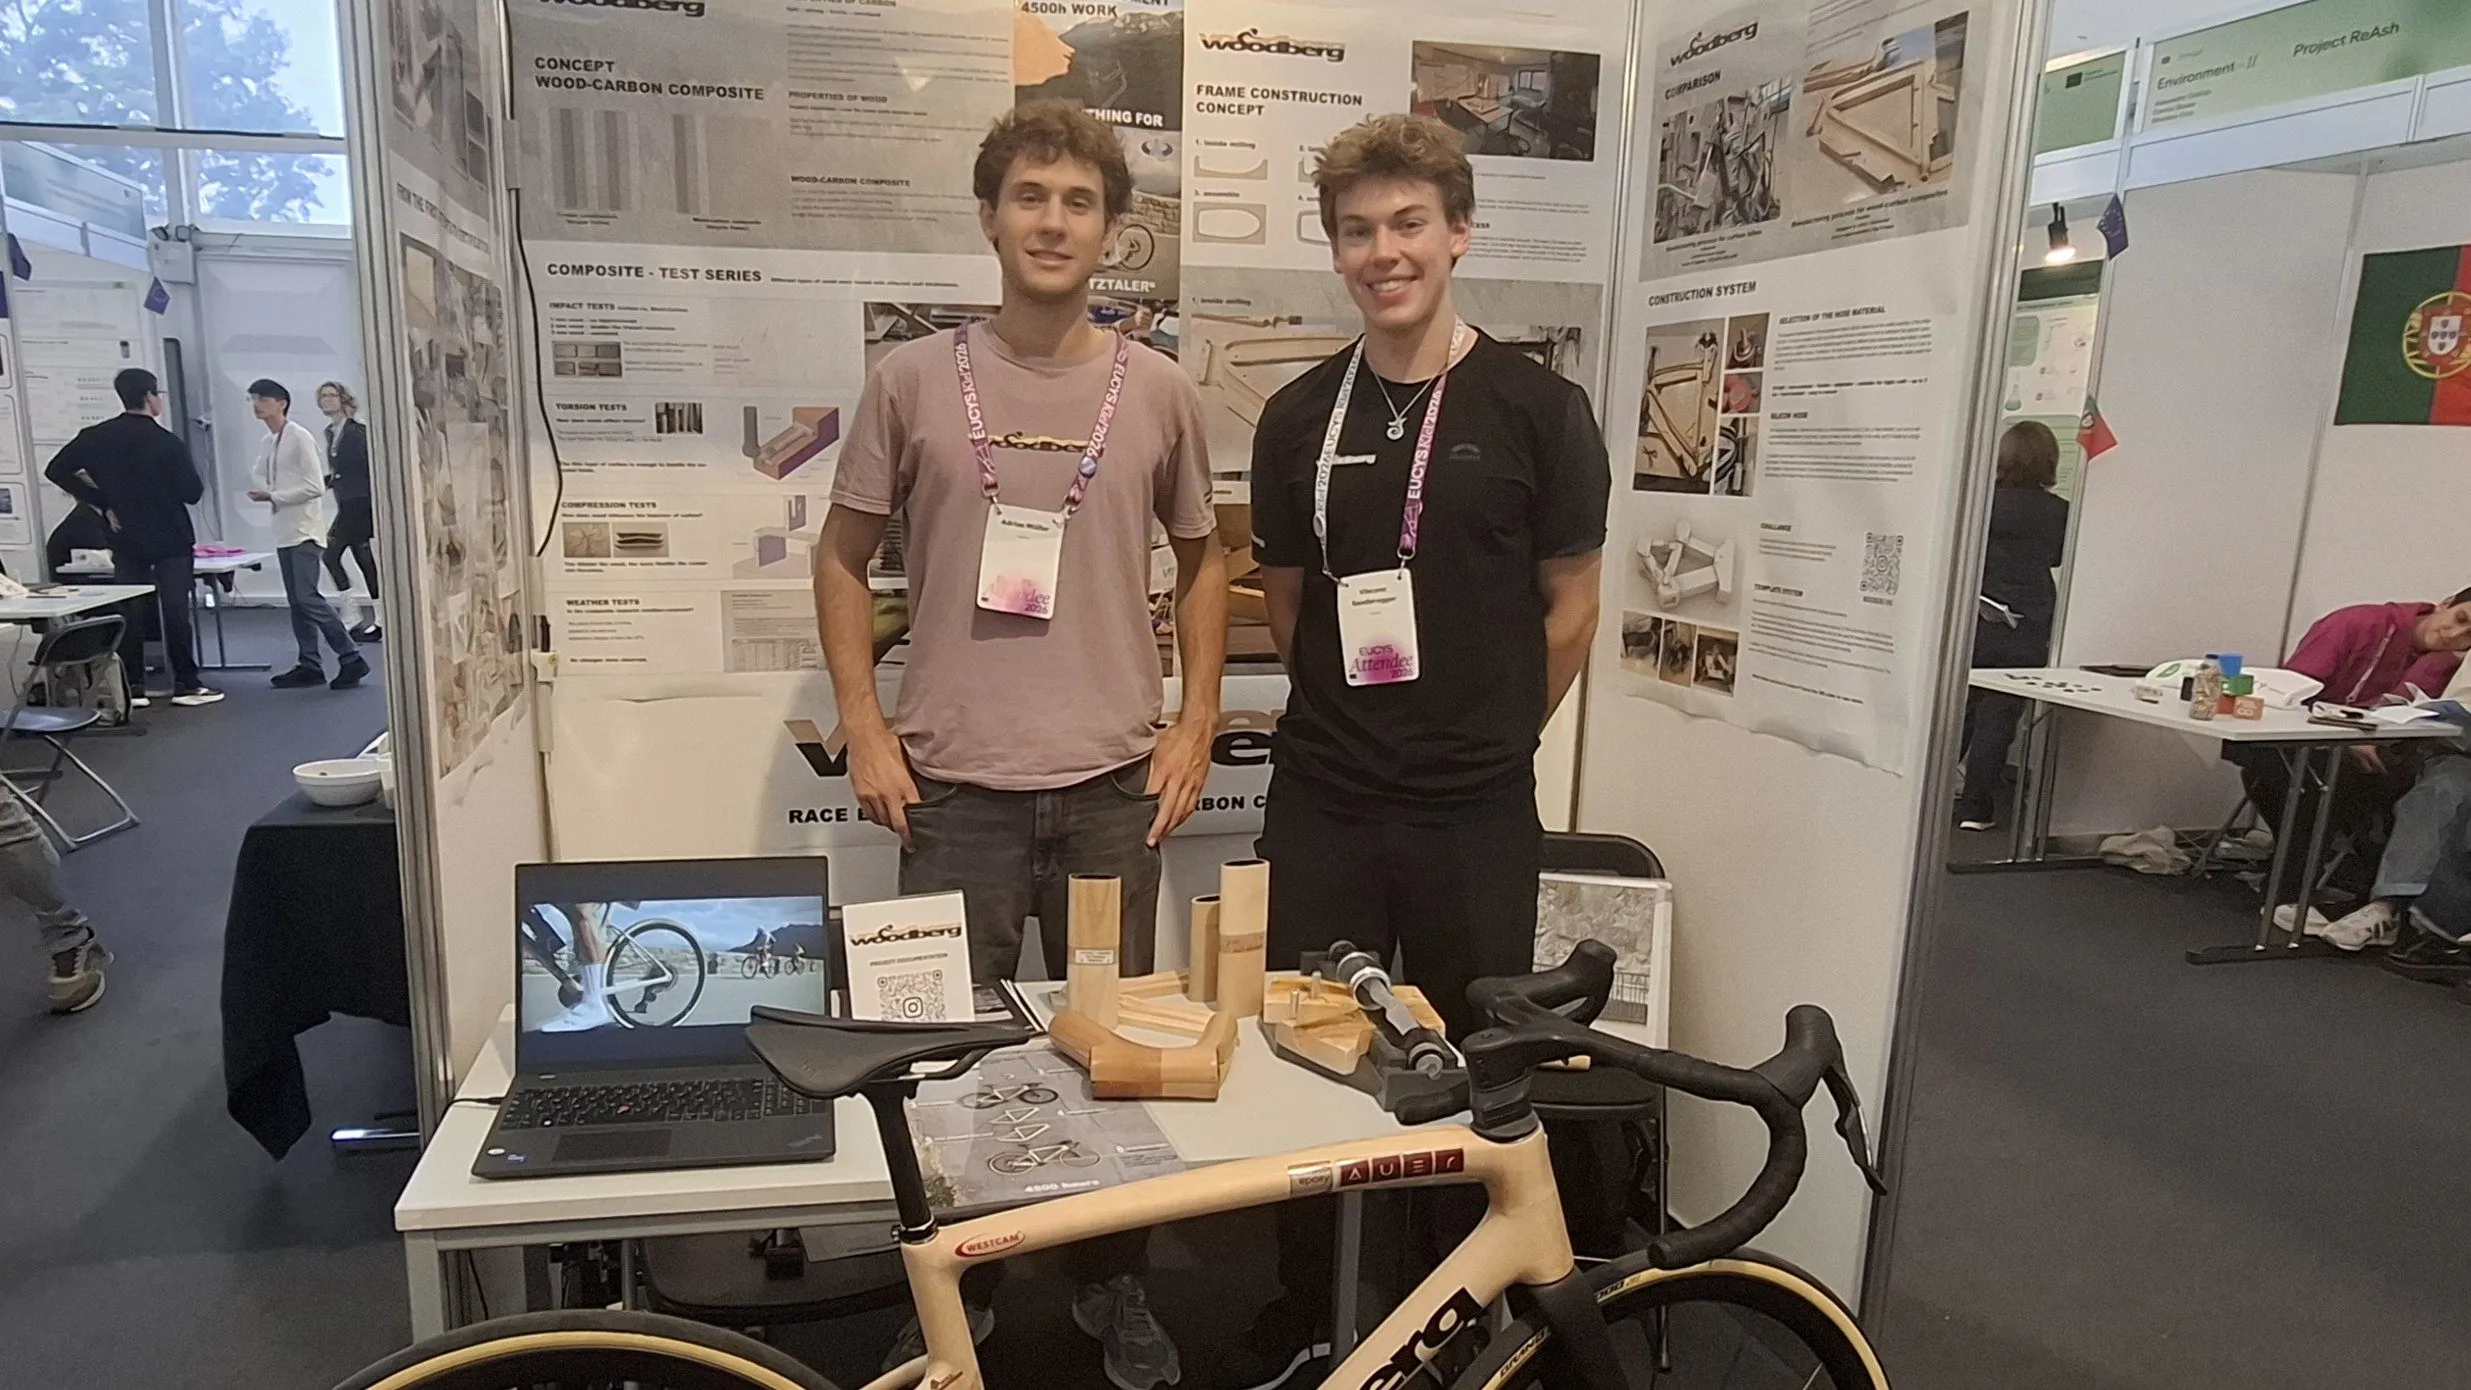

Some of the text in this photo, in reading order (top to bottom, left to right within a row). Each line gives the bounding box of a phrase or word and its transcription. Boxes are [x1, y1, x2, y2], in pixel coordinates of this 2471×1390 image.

[1020, 3, 1118, 17] 4500h WORK
[1202, 28, 1346, 62] woodberg
[1669, 21, 1759, 67] woodberg
[2293, 21, 2400, 58] Project ReAsh
[534, 57, 616, 73] CONCEPT
[2157, 61, 2236, 91] Environment
[535, 75, 765, 100] WOOD-CARBON COMPOSITE
[1196, 84, 1363, 106] FRAME CONSTRUCTION
[1664, 70, 1722, 101] COMPARISON
[1196, 102, 1265, 116] CONCEPT
[1135, 113, 1164, 128] FOR
[547, 263, 645, 279] COMPOSITE
[658, 266, 700, 280] TEST
[704, 268, 762, 283] SERIES
[1716, 281, 1757, 297] SYSTEM
[549, 302, 583, 310] IMPACT
[586, 303, 615, 311] TESTS
[956, 342, 972, 372] 2026
[1106, 362, 1127, 405] EUCYS
[963, 390, 986, 440] EUCYS
[1086, 422, 1108, 458] 2026
[1326, 409, 1344, 455] EUCYS
[1408, 449, 1428, 499] EUCYS
[566, 598, 640, 606] WEATHER TESTS
[1358, 644, 1394, 656] EUCYS
[1349, 652, 1414, 673] Attendee
[788, 807, 848, 824] RACE
[850, 924, 962, 946] woodberg
